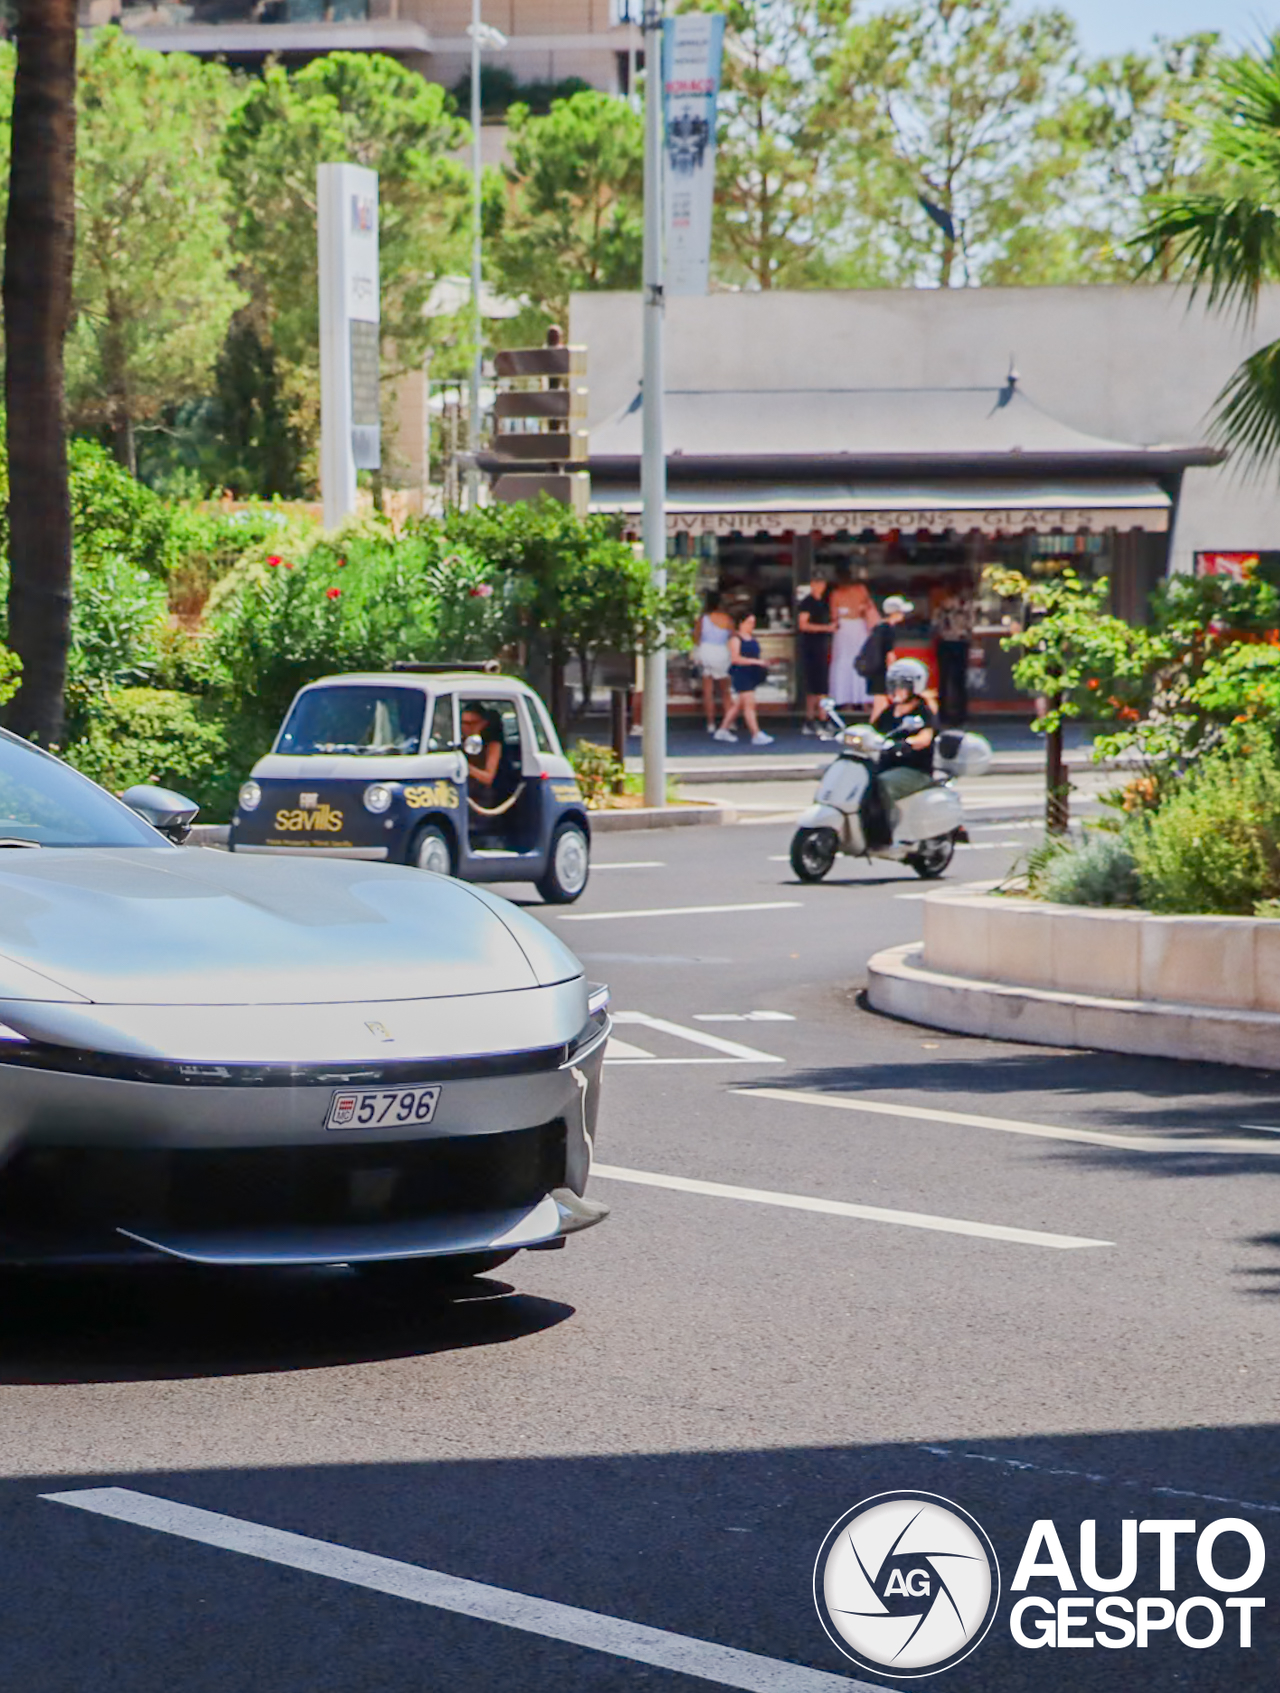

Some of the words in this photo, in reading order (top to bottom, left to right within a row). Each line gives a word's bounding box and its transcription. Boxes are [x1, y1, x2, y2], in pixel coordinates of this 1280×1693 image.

[622, 514, 781, 529] SUVENIRS
[812, 512, 953, 528] BOISSONS
[983, 510, 1093, 526] GLACES
[274, 803, 344, 832] savills
[357, 1091, 435, 1124] 5796
